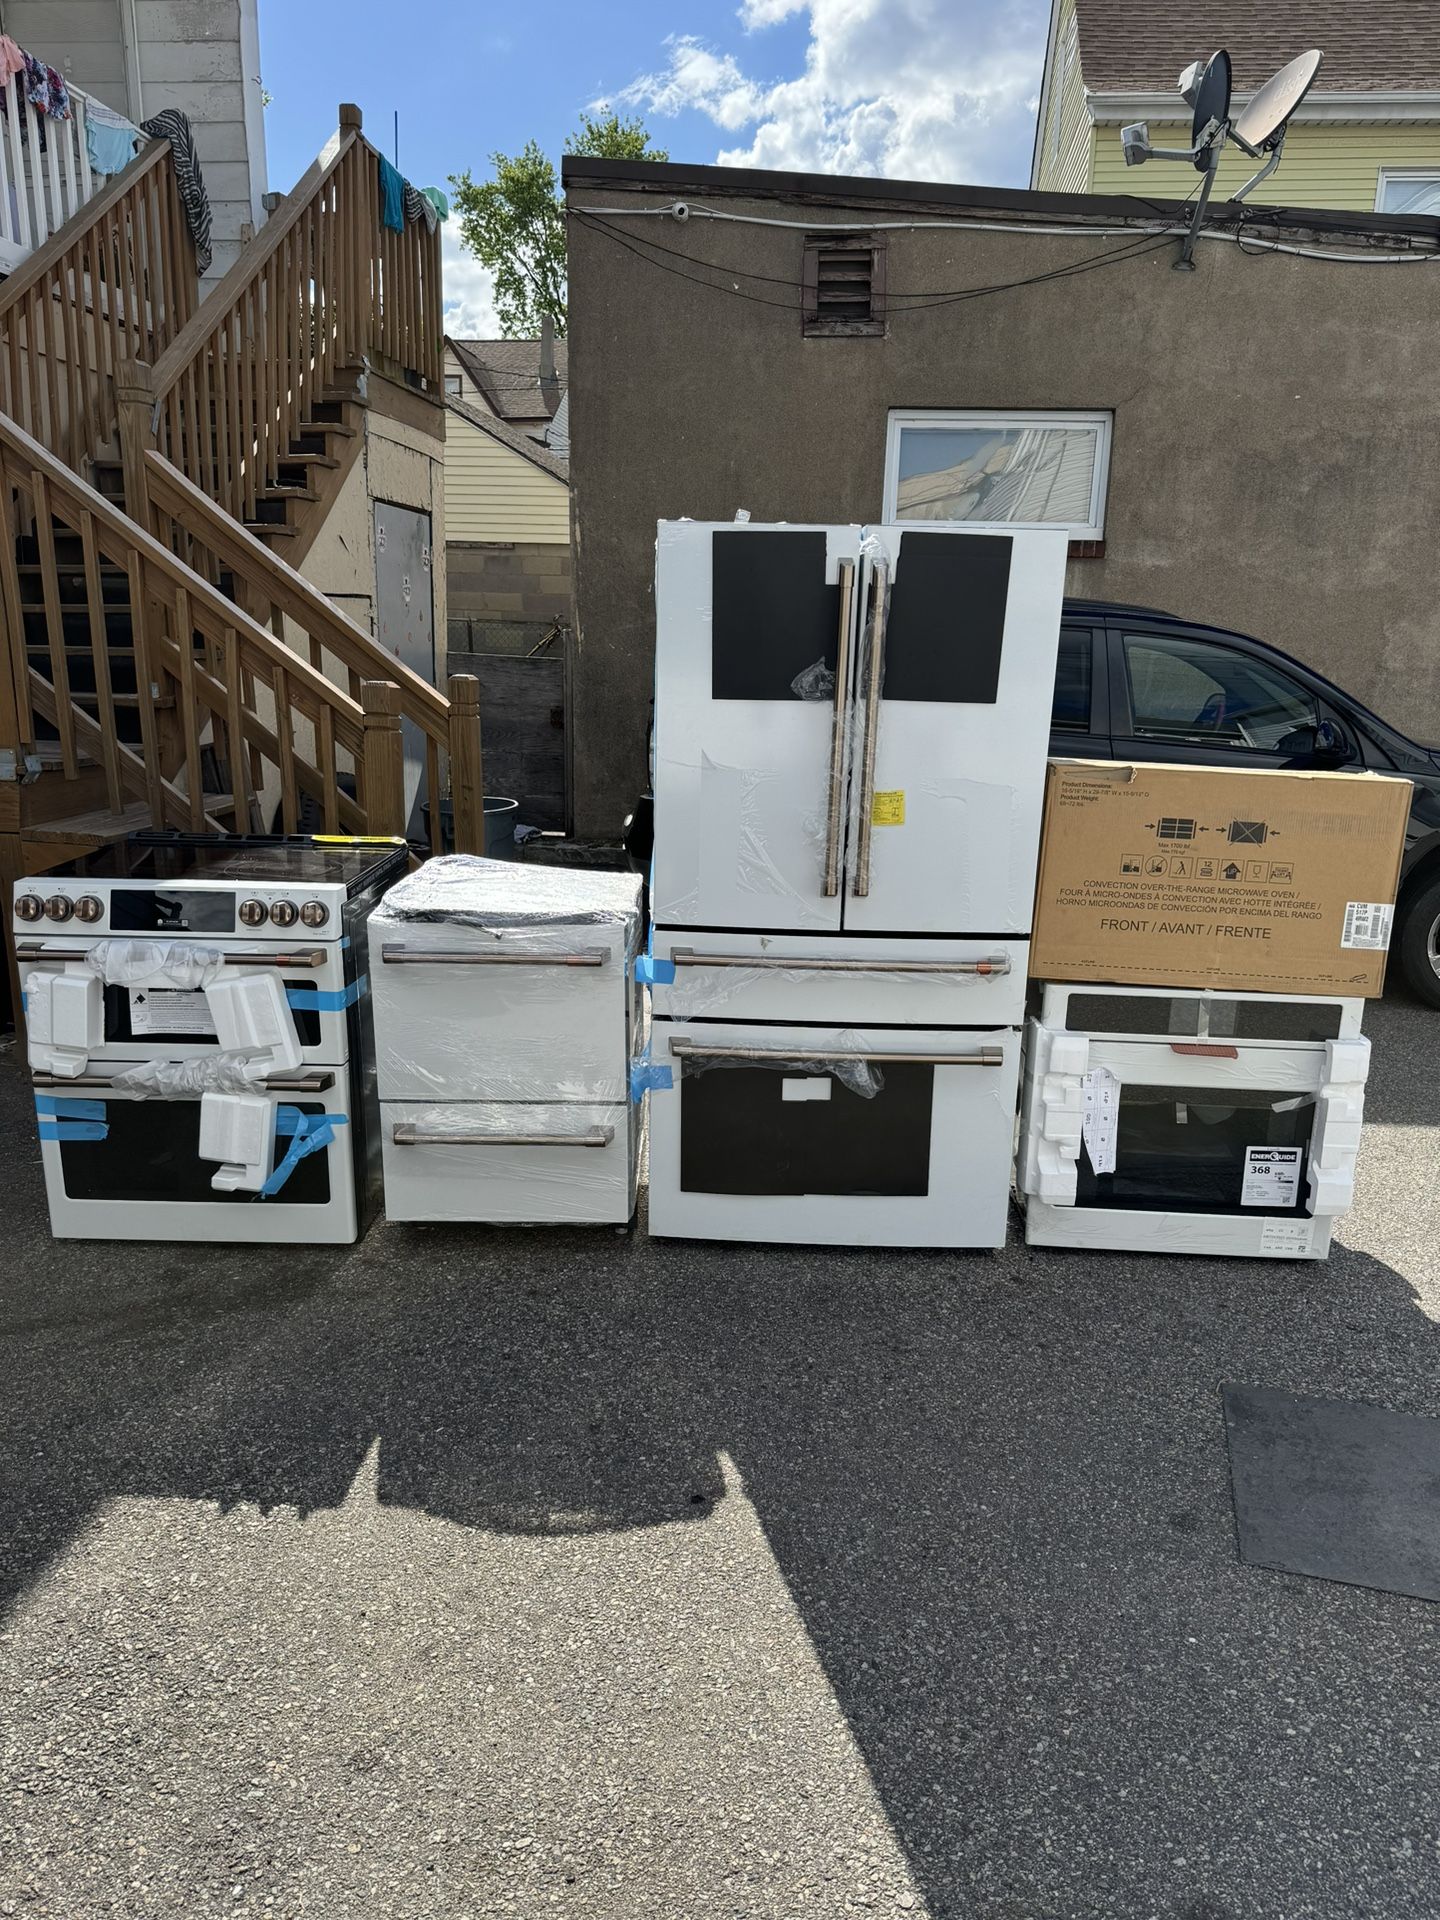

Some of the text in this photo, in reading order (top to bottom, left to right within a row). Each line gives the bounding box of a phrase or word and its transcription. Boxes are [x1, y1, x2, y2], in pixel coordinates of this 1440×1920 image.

[1059, 888, 1083, 897] FOUR
[1093, 890, 1152, 901] MICRO-ONDES
[1162, 893, 1218, 905] CONVECTION
[1219, 897, 1242, 906] AVEC
[1083, 880, 1139, 890] CONVECTION
[1140, 883, 1216, 894] OVER-THE-RANGE
[1217, 887, 1269, 898] MICROWAVE
[1271, 890, 1295, 899] OVEN
[1055, 898, 1087, 907] HORNO
[1088, 899, 1145, 910] MICROONDAS
[1147, 902, 1160, 910] DE
[1219, 906, 1238, 915] POR
[1239, 907, 1272, 917] ENCIMA
[1273, 910, 1290, 918] DEL
[1291, 911, 1322, 920] RANGO
[1100, 918, 1149, 932] FRONT
[1158, 922, 1205, 935] AVANT
[1215, 925, 1272, 939] FRENTE
[1251, 1166, 1270, 1174] 368
